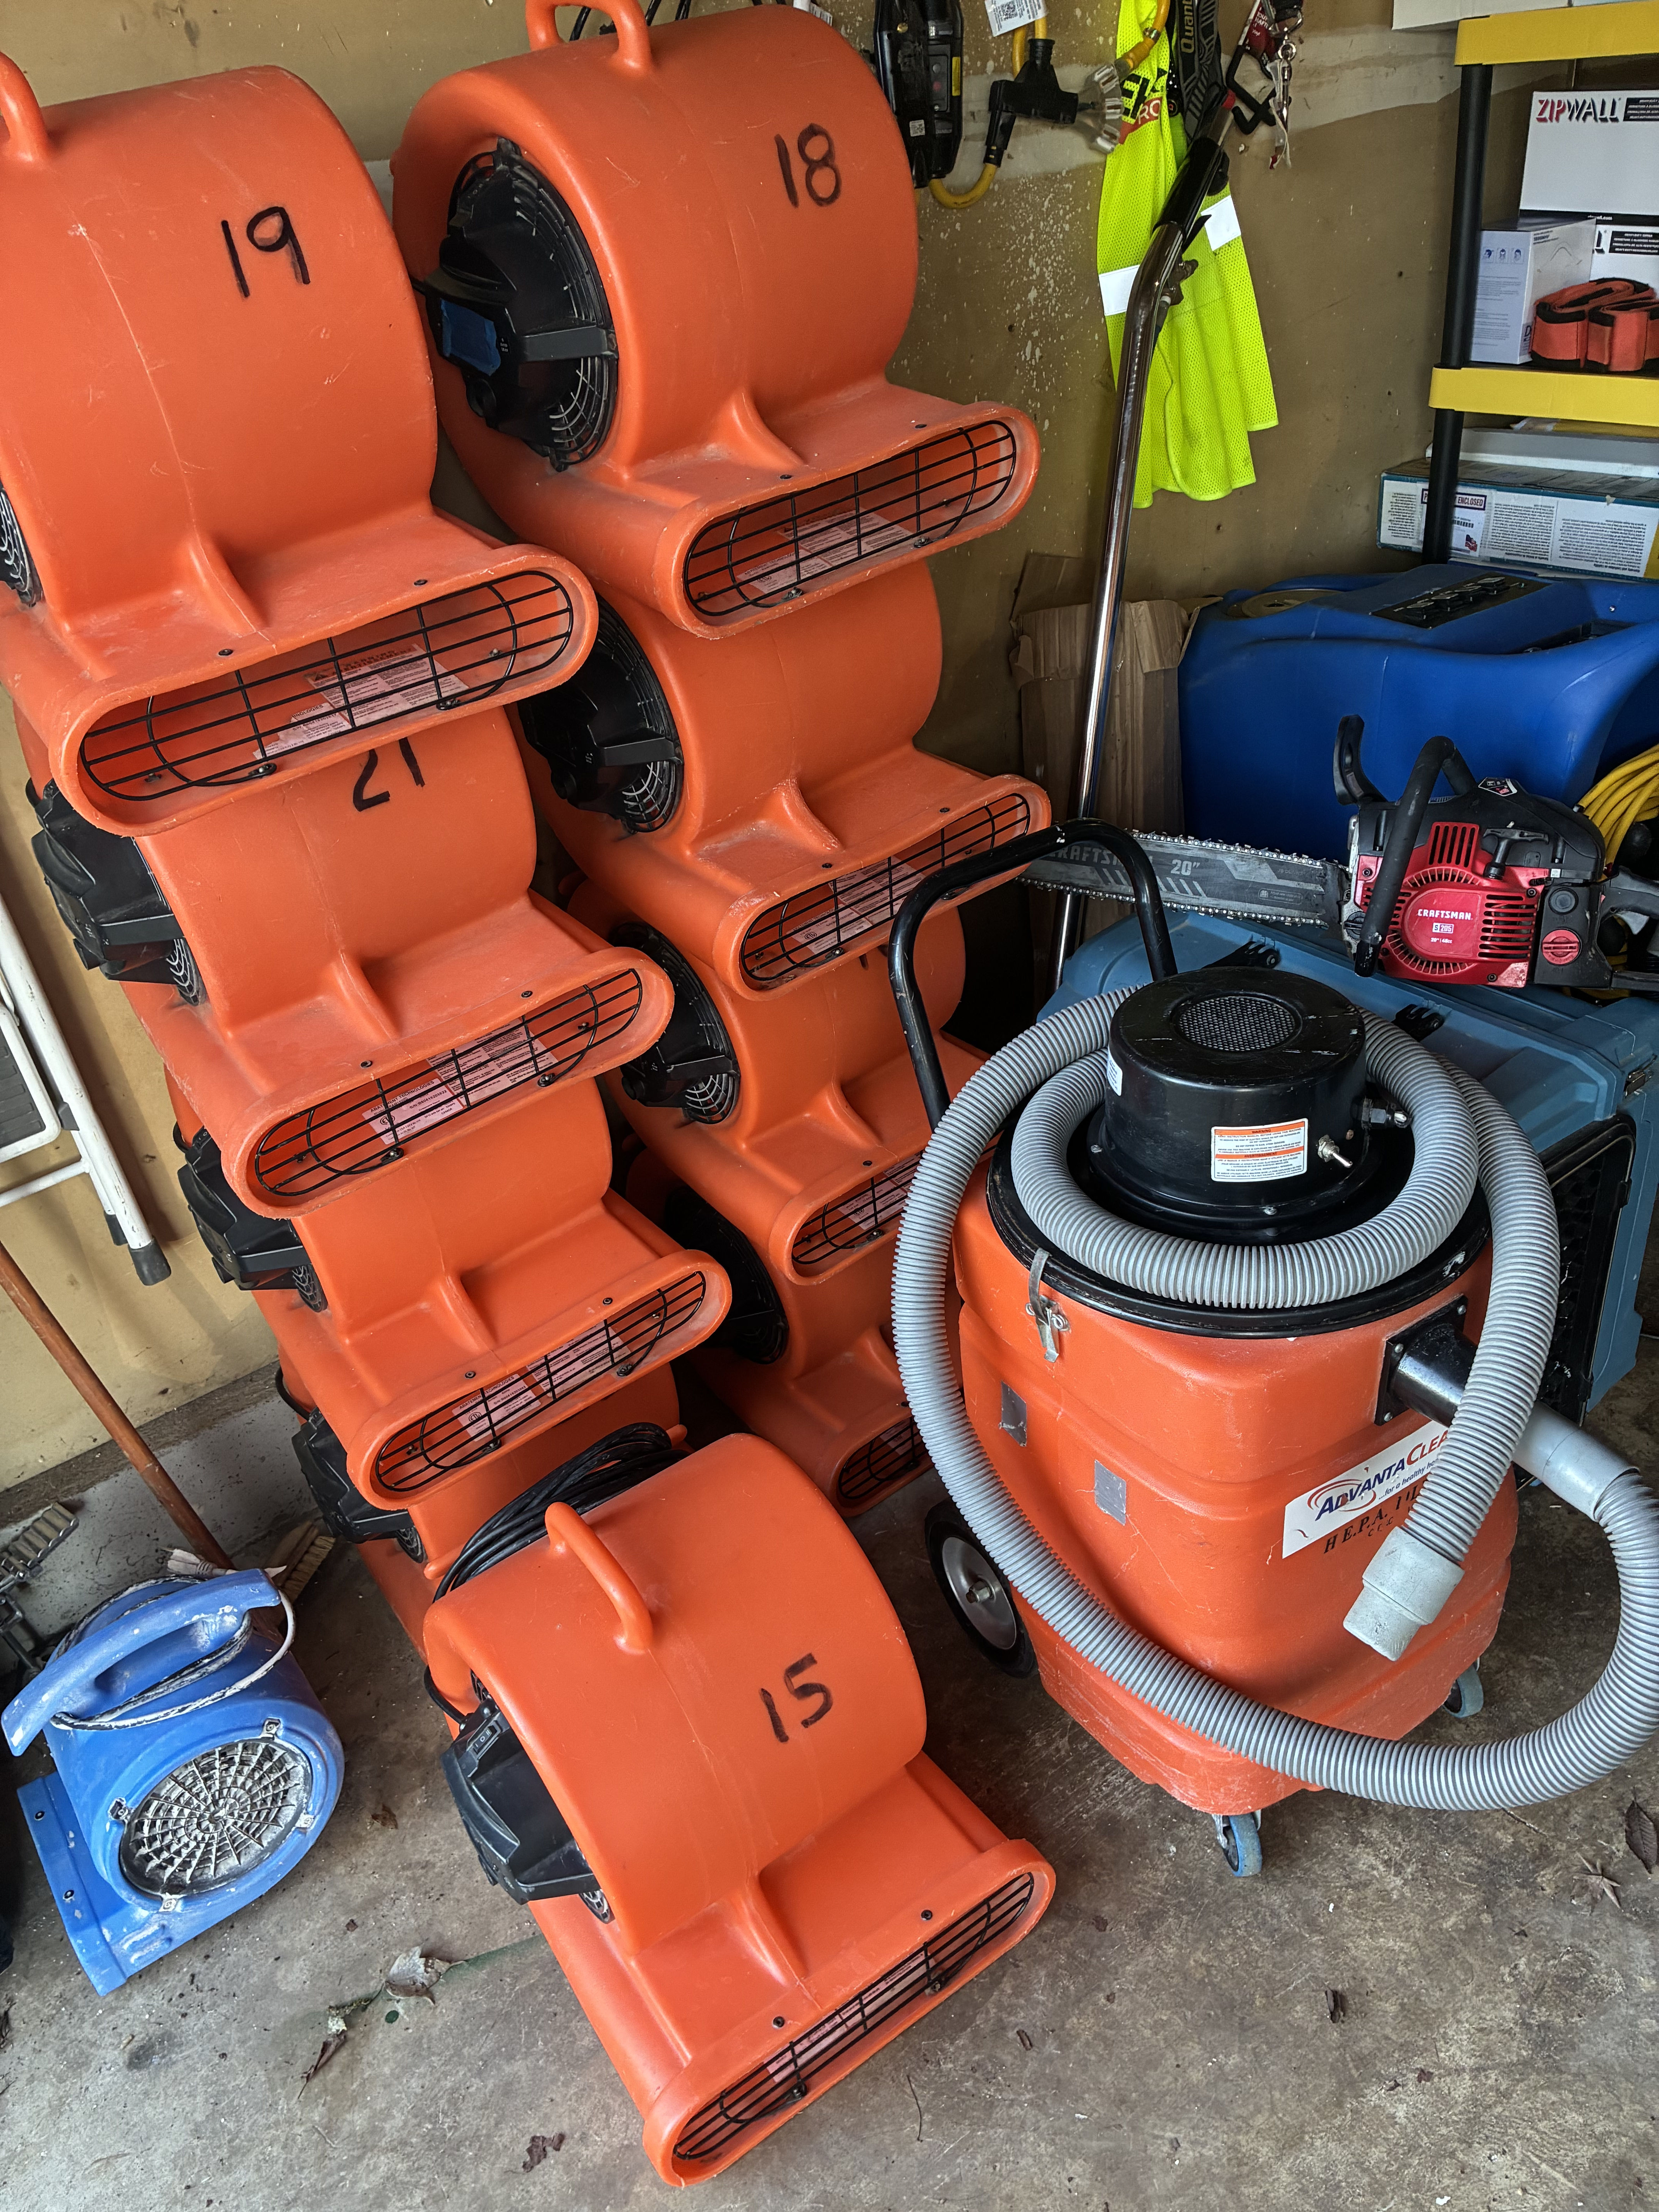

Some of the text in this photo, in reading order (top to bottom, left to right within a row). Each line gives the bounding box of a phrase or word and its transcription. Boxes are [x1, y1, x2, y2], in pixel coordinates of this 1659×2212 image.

[1536, 98, 1619, 123] ZIPWALL
[775, 123, 842, 208] 18
[221, 206, 310, 298] 19
[1458, 497, 1483, 507] ENCLOSED
[353, 737, 425, 812] 21
[1171, 859, 1200, 876] 20"
[1417, 909, 1472, 920] CRAFTSMAN
[1315, 1430, 1449, 1521] ADVANTACLEA
[1402, 1466, 1425, 1486] healthy
[759, 1653, 833, 1743] 15
